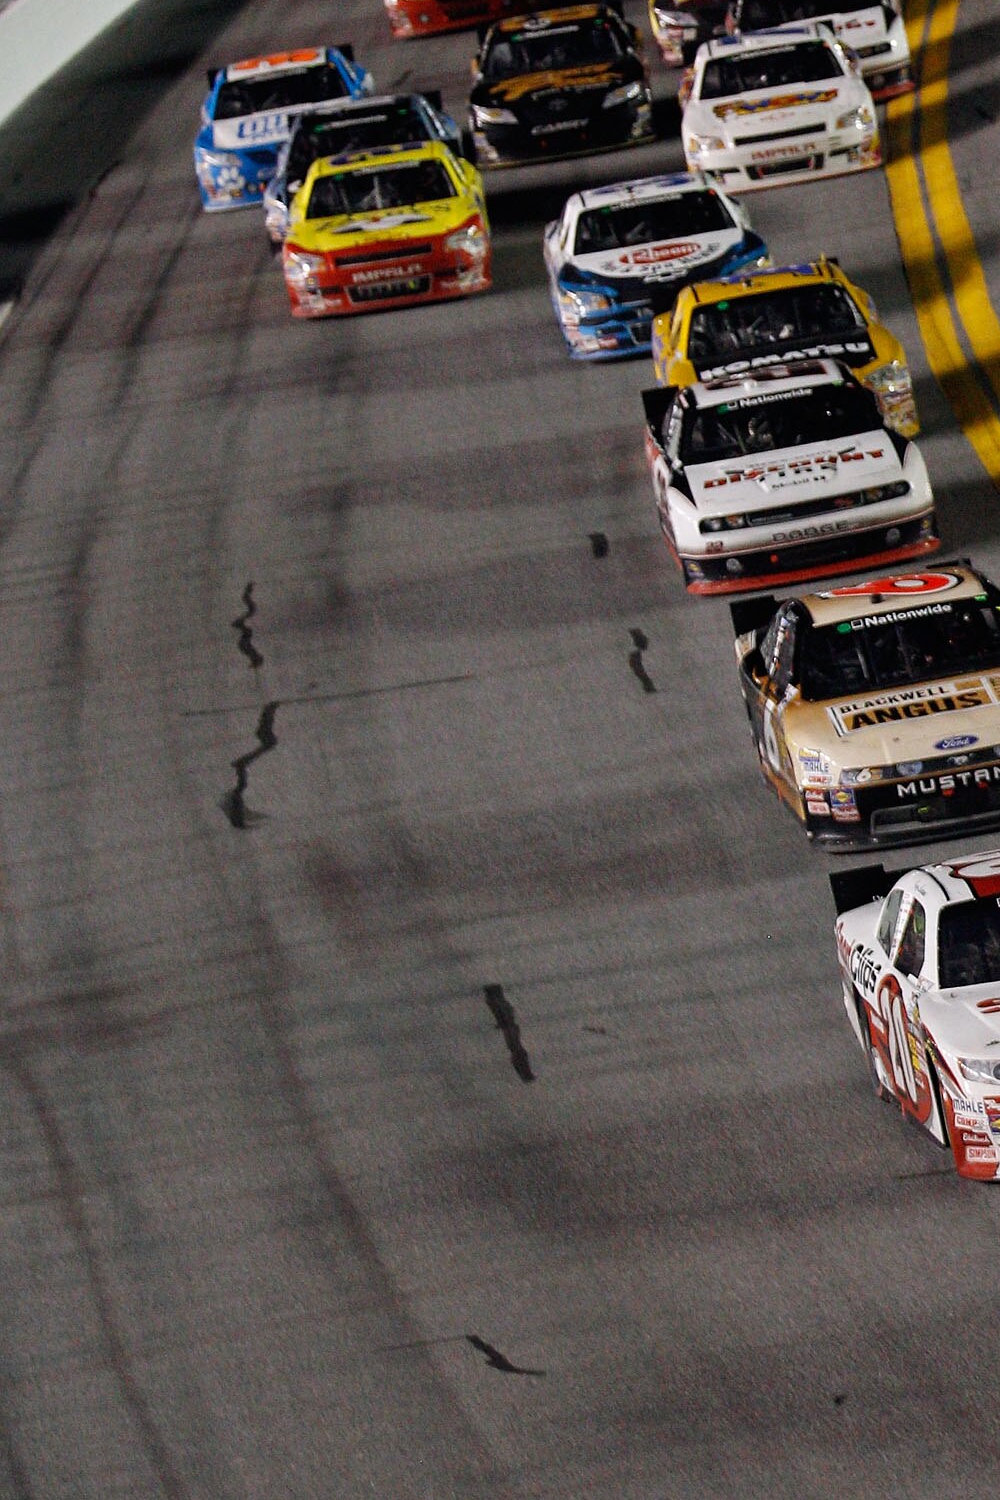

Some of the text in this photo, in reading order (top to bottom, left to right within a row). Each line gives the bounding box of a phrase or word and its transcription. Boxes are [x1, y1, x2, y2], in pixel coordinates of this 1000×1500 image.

[740, 388, 813, 408] Nationwide
[773, 520, 848, 542] DODGE
[865, 602, 952, 627] Nationwide
[840, 686, 950, 714] BLACKWELL
[852, 692, 983, 730] ANGUS
[941, 736, 972, 749] Ford
[953, 1099, 983, 1114] MAHLE
